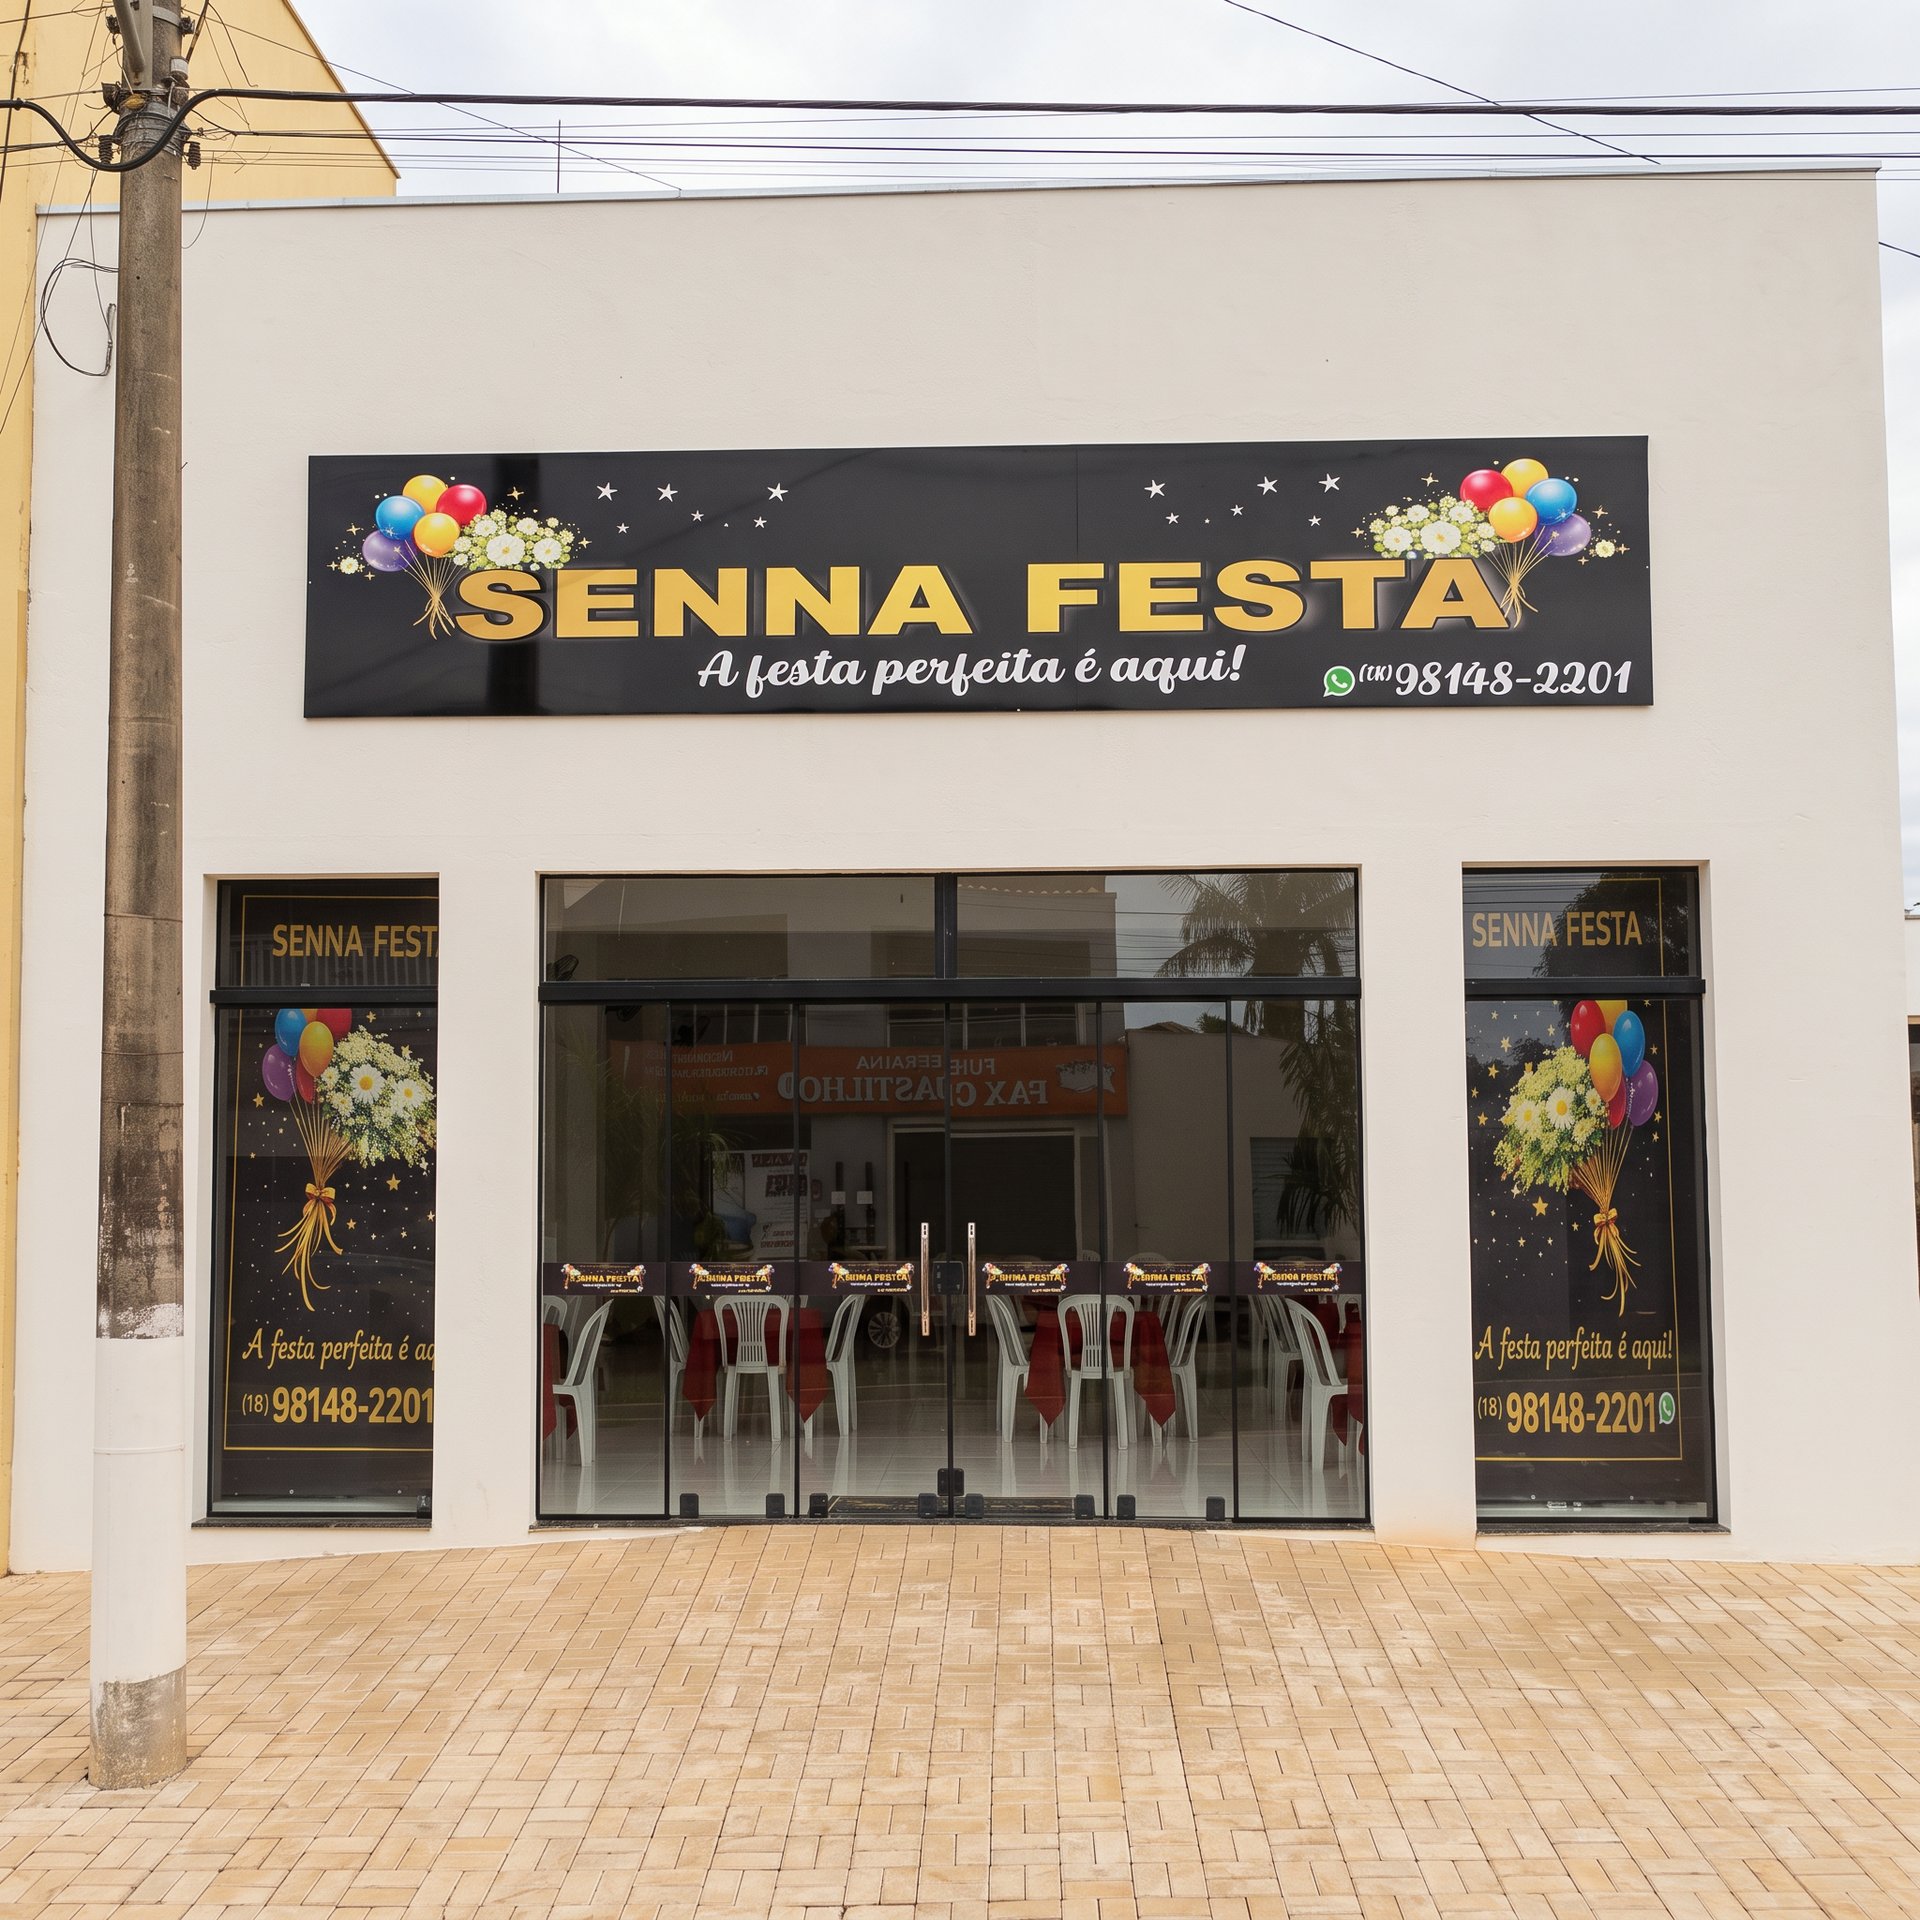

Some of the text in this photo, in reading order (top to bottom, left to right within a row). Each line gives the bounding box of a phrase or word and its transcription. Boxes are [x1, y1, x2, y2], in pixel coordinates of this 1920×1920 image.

[454, 558, 1508, 640] SENNA FESTA
[697, 644, 1247, 698] A festa perfeita é aqui!
[1395, 661, 1632, 696] 98148-2201
[272, 924, 439, 958] SENNA FEST
[1472, 910, 1643, 947] SENNA FESTA
[242, 1327, 264, 1360] A
[267, 1328, 315, 1370] festa
[319, 1328, 393, 1371] perfeita
[398, 1335, 410, 1361] é
[1474, 1325, 1673, 1371] A festa perfeita é aqui!
[241, 1386, 433, 1424] (18) 98148-2201
[1477, 1391, 1656, 1434] (18) 98148-2201
